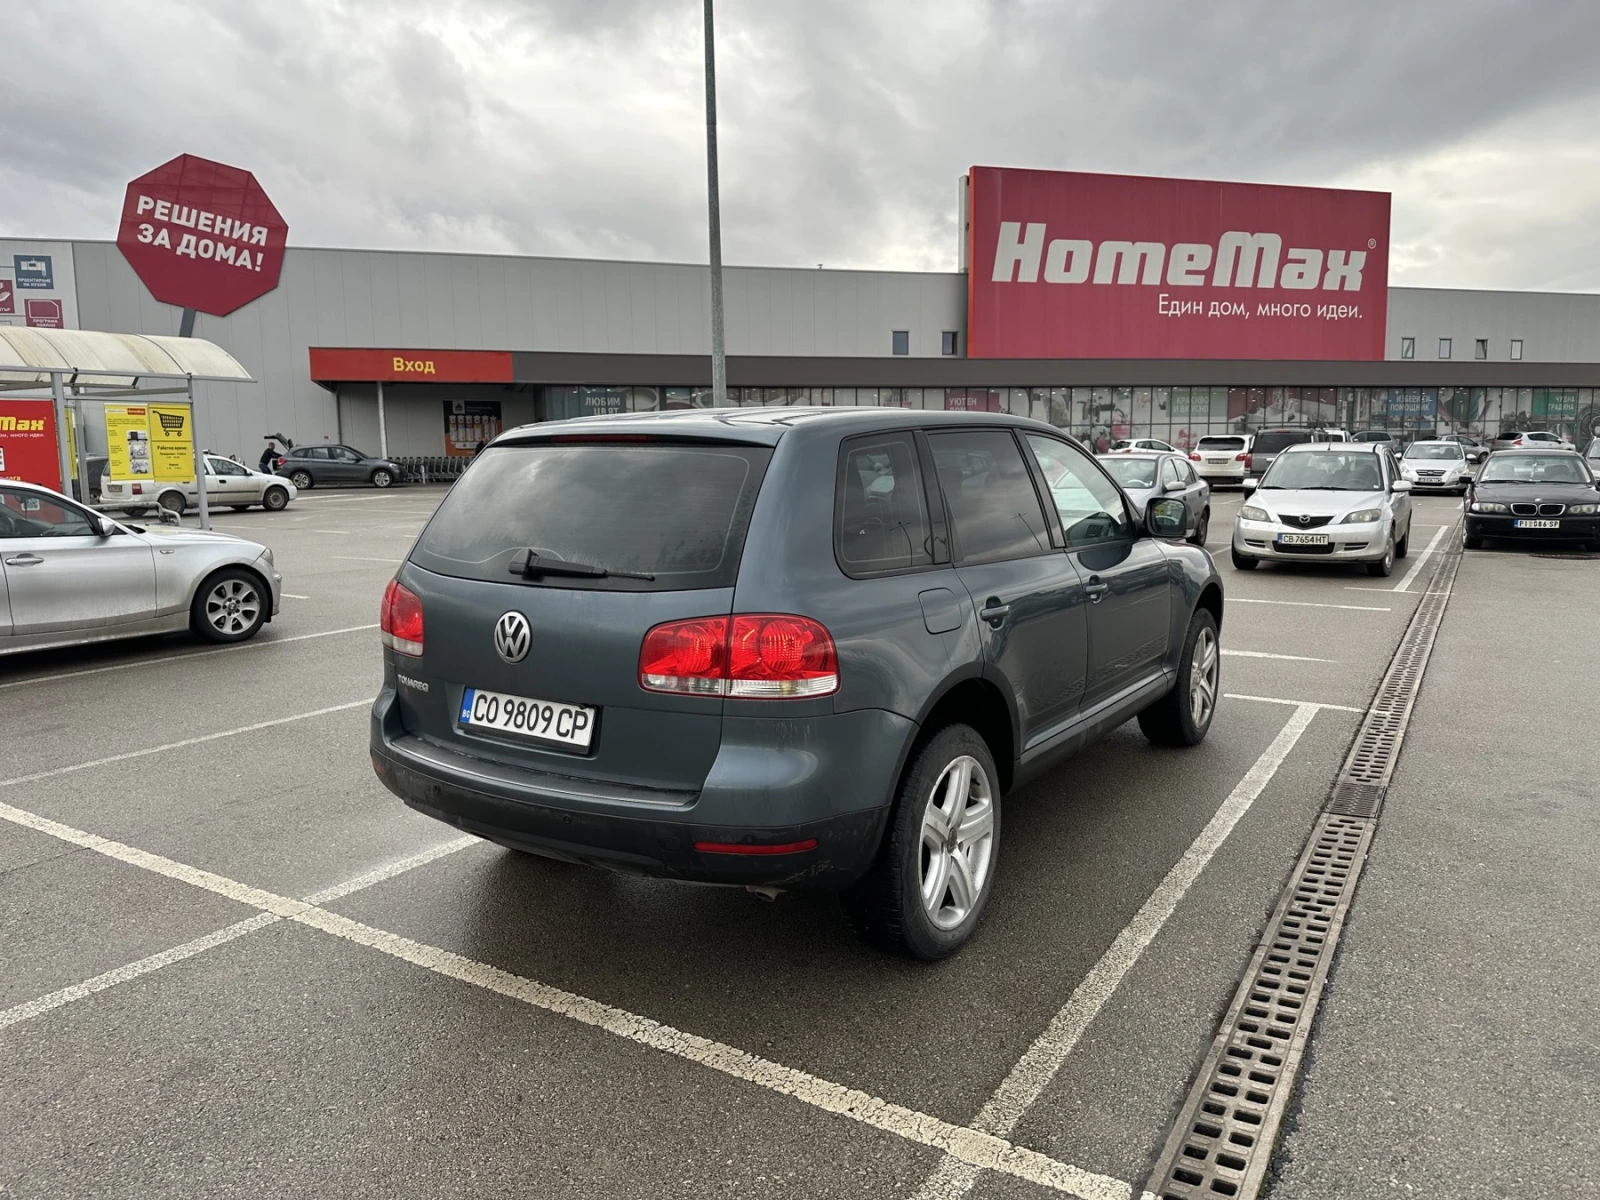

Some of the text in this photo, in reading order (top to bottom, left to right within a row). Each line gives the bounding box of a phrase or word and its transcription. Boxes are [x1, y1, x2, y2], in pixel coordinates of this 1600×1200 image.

[137, 195, 268, 247] РЕШЕНИЯ
[137, 224, 264, 272] ЗА ДОМА!
[991, 221, 1367, 292] HomeMax
[1158, 293, 1363, 321] Един дом, много идеи.
[392, 357, 436, 375] Вход
[585, 396, 621, 406] ЛЮБИМ
[949, 397, 977, 406] УЮТЕН
[1176, 396, 1209, 405] КРАСИВО
[1555, 395, 1576, 403] ЧУДНА
[1173, 405, 1209, 413] И ВКУСНО
[1390, 403, 1430, 412] ПОМОЩНИК
[1548, 403, 1575, 411] ГРАДИНА
[1283, 535, 1327, 544] CB 7654 HT
[397, 673, 429, 693] TOUAREG
[462, 693, 588, 740] BG CO 9809 CP
